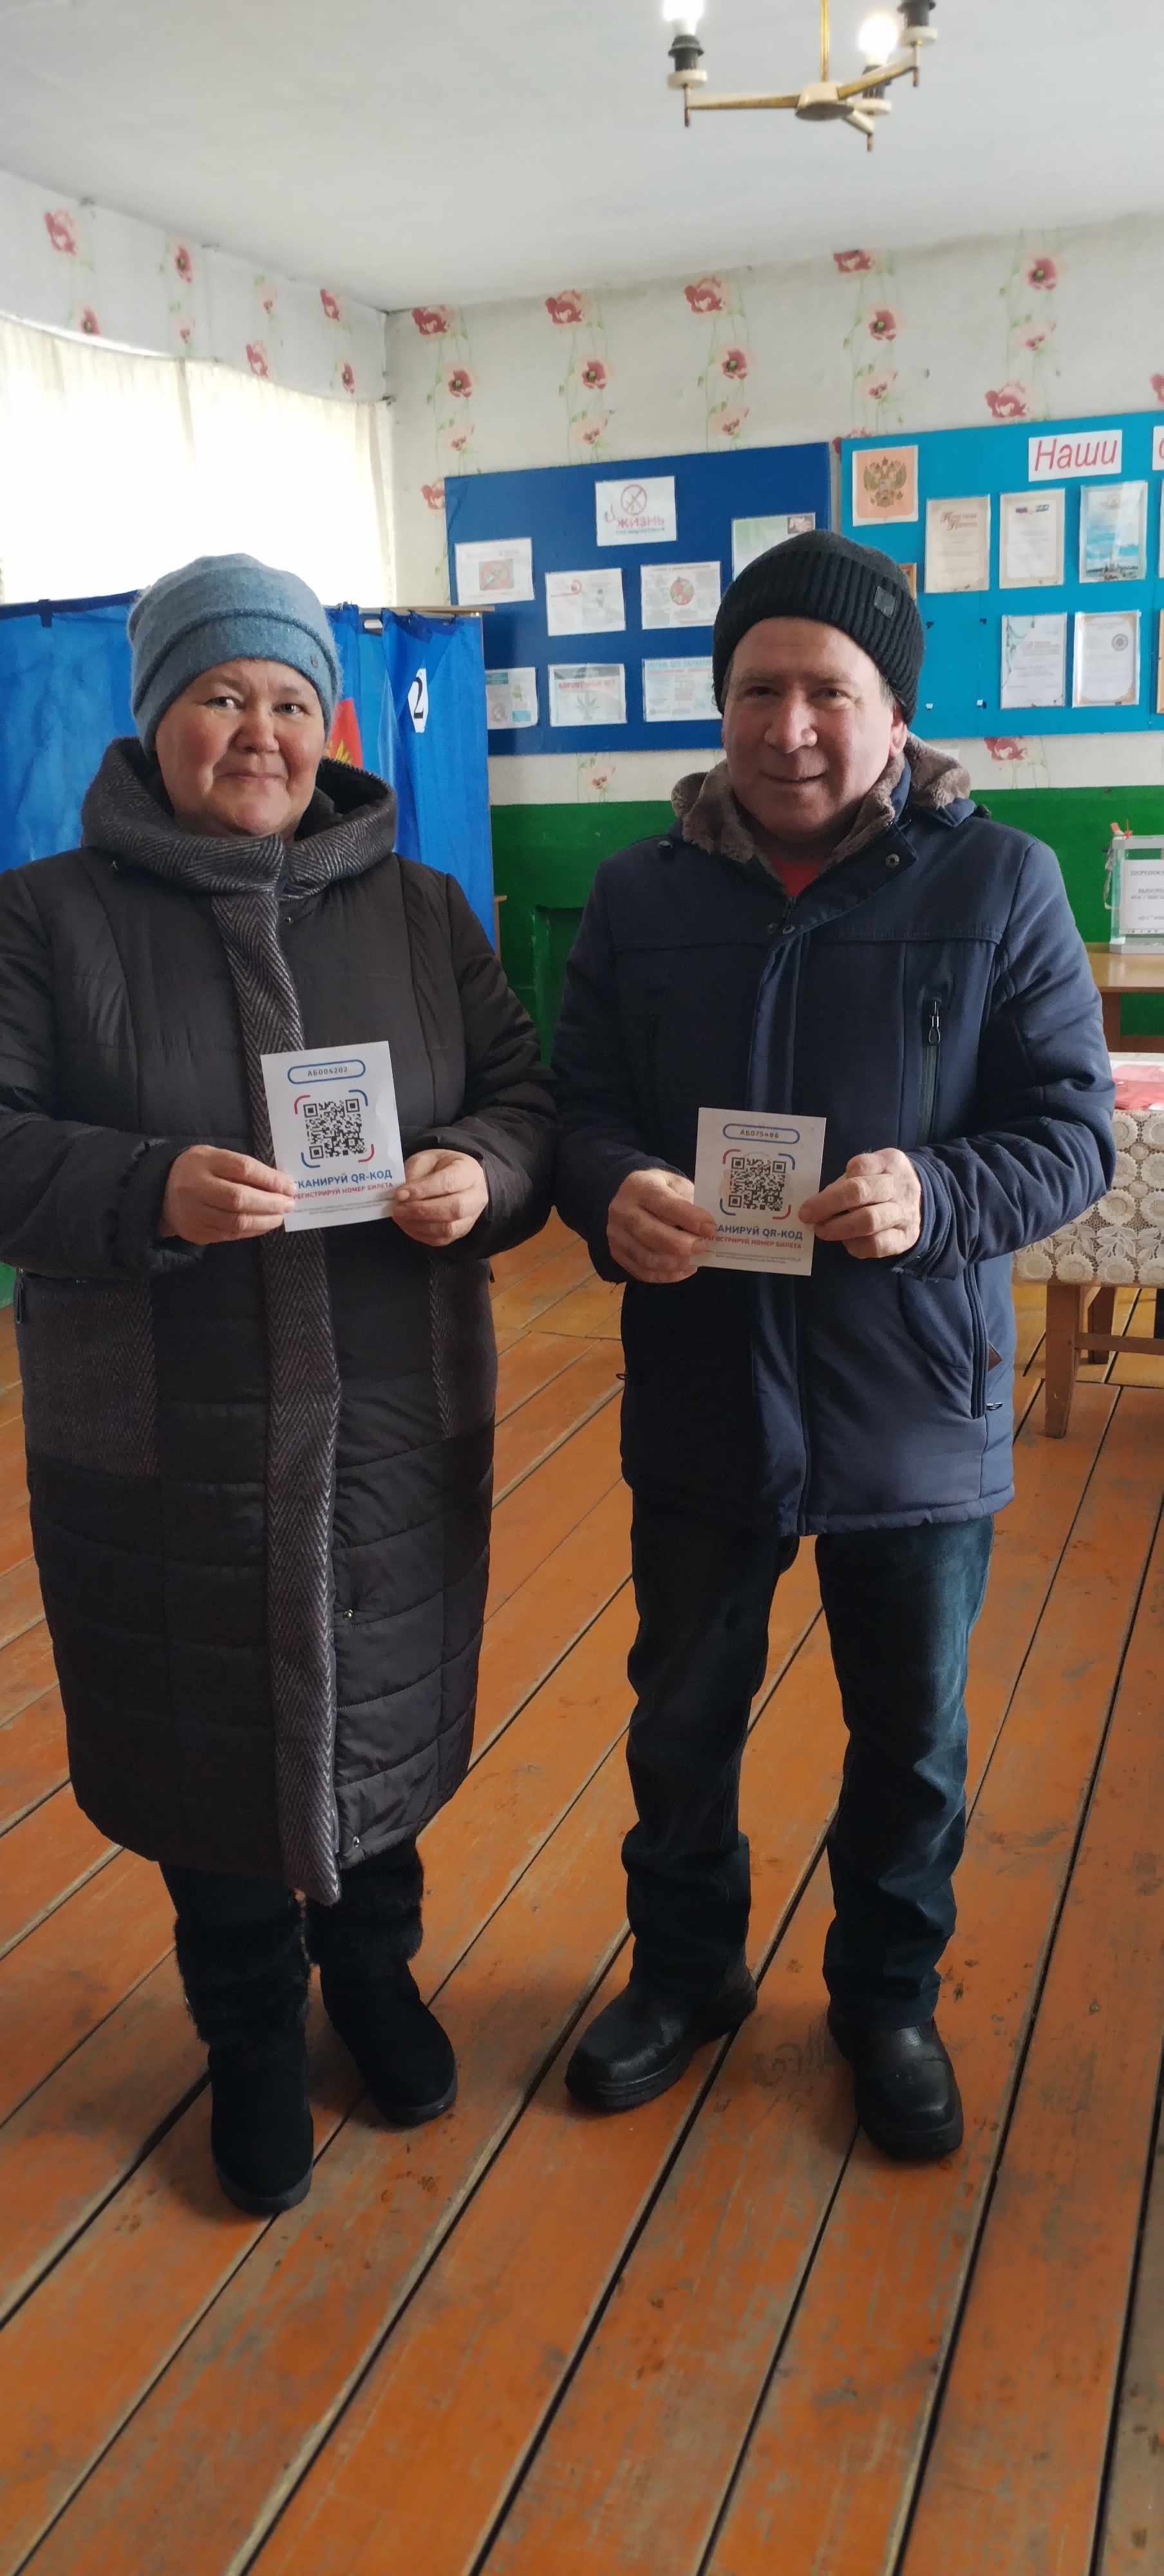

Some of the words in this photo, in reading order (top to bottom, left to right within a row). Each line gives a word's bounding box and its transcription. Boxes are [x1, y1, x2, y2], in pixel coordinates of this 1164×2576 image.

[1034, 439, 1118, 471] Наши
[413, 677, 424, 719] 2
[351, 1170, 393, 1184] QR-КОД
[293, 1188, 341, 1200] РЕГИСТРИРУЙ
[342, 1186, 366, 1194] НОМЕР
[368, 1182, 393, 1191] БИЛЕТА
[715, 1224, 760, 1236] АНИРУЙ
[762, 1228, 803, 1241] QR-КОД
